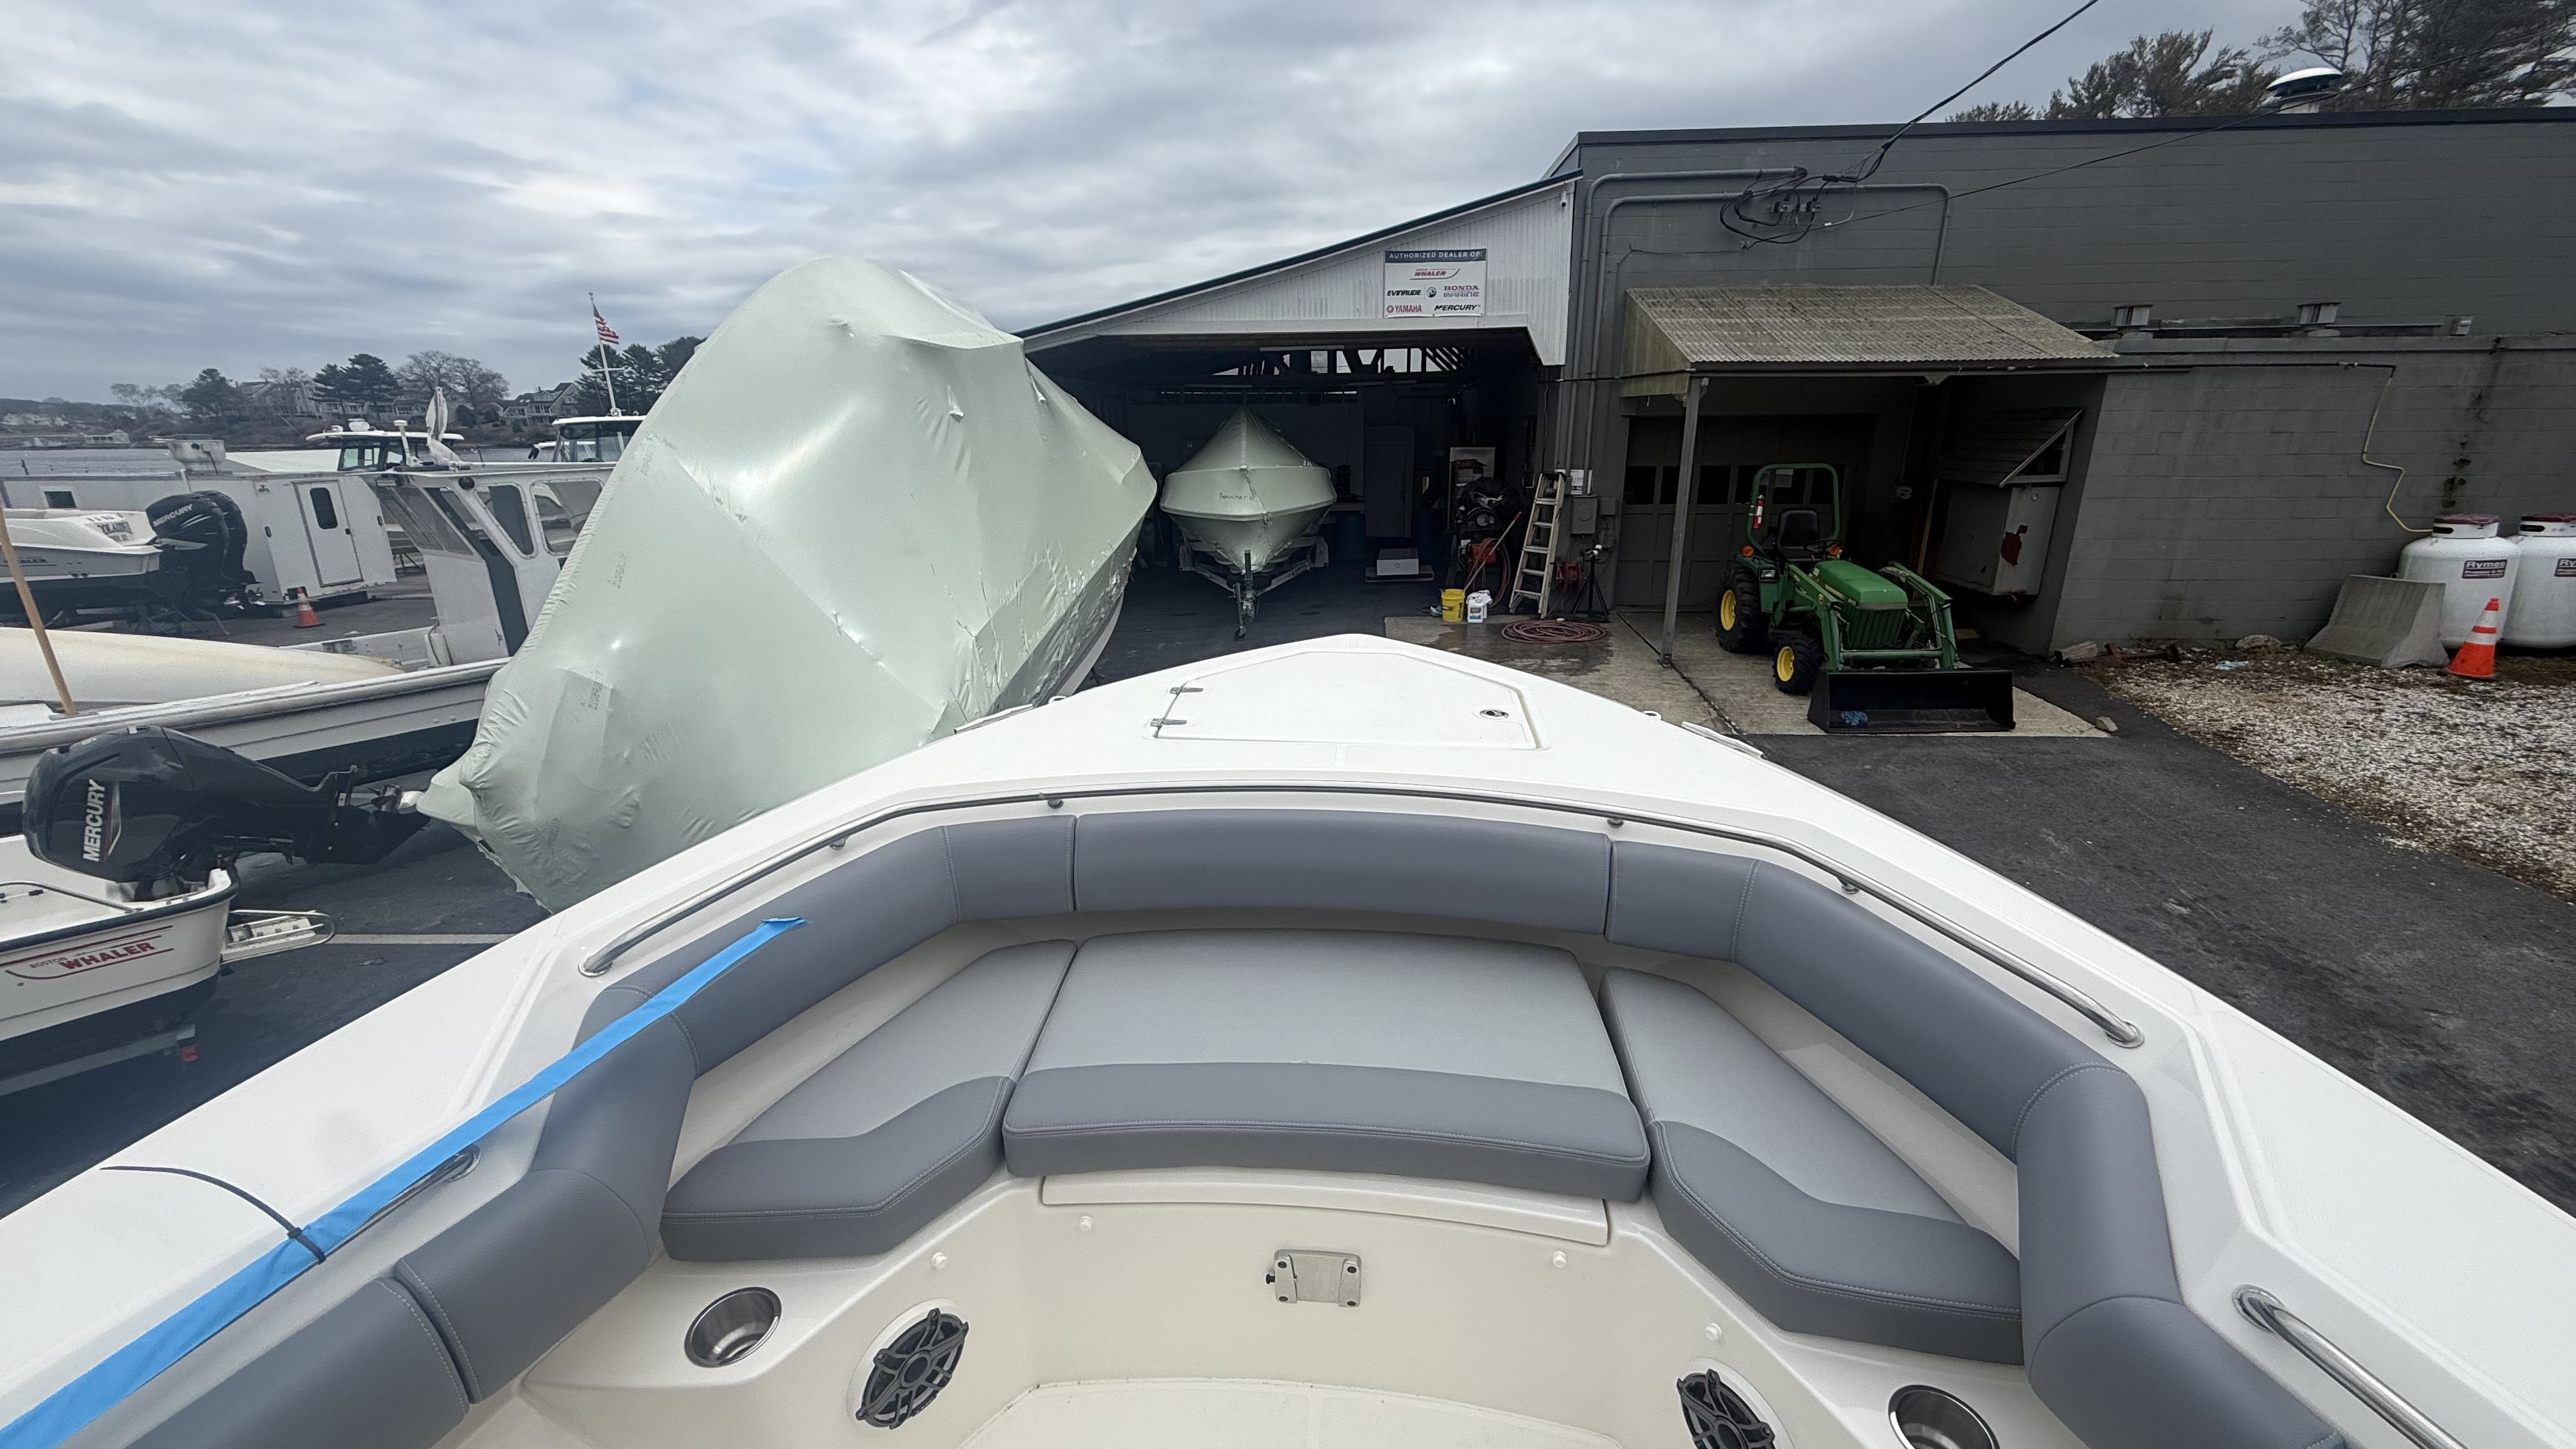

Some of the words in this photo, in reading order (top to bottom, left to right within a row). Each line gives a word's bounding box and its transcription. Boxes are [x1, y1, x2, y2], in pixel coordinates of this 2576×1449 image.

[153, 503, 193, 527] MERCURY
[82, 778, 105, 862] MERCURY
[29, 956, 68, 969] BOSTON
[58, 942, 155, 970] WHALER
